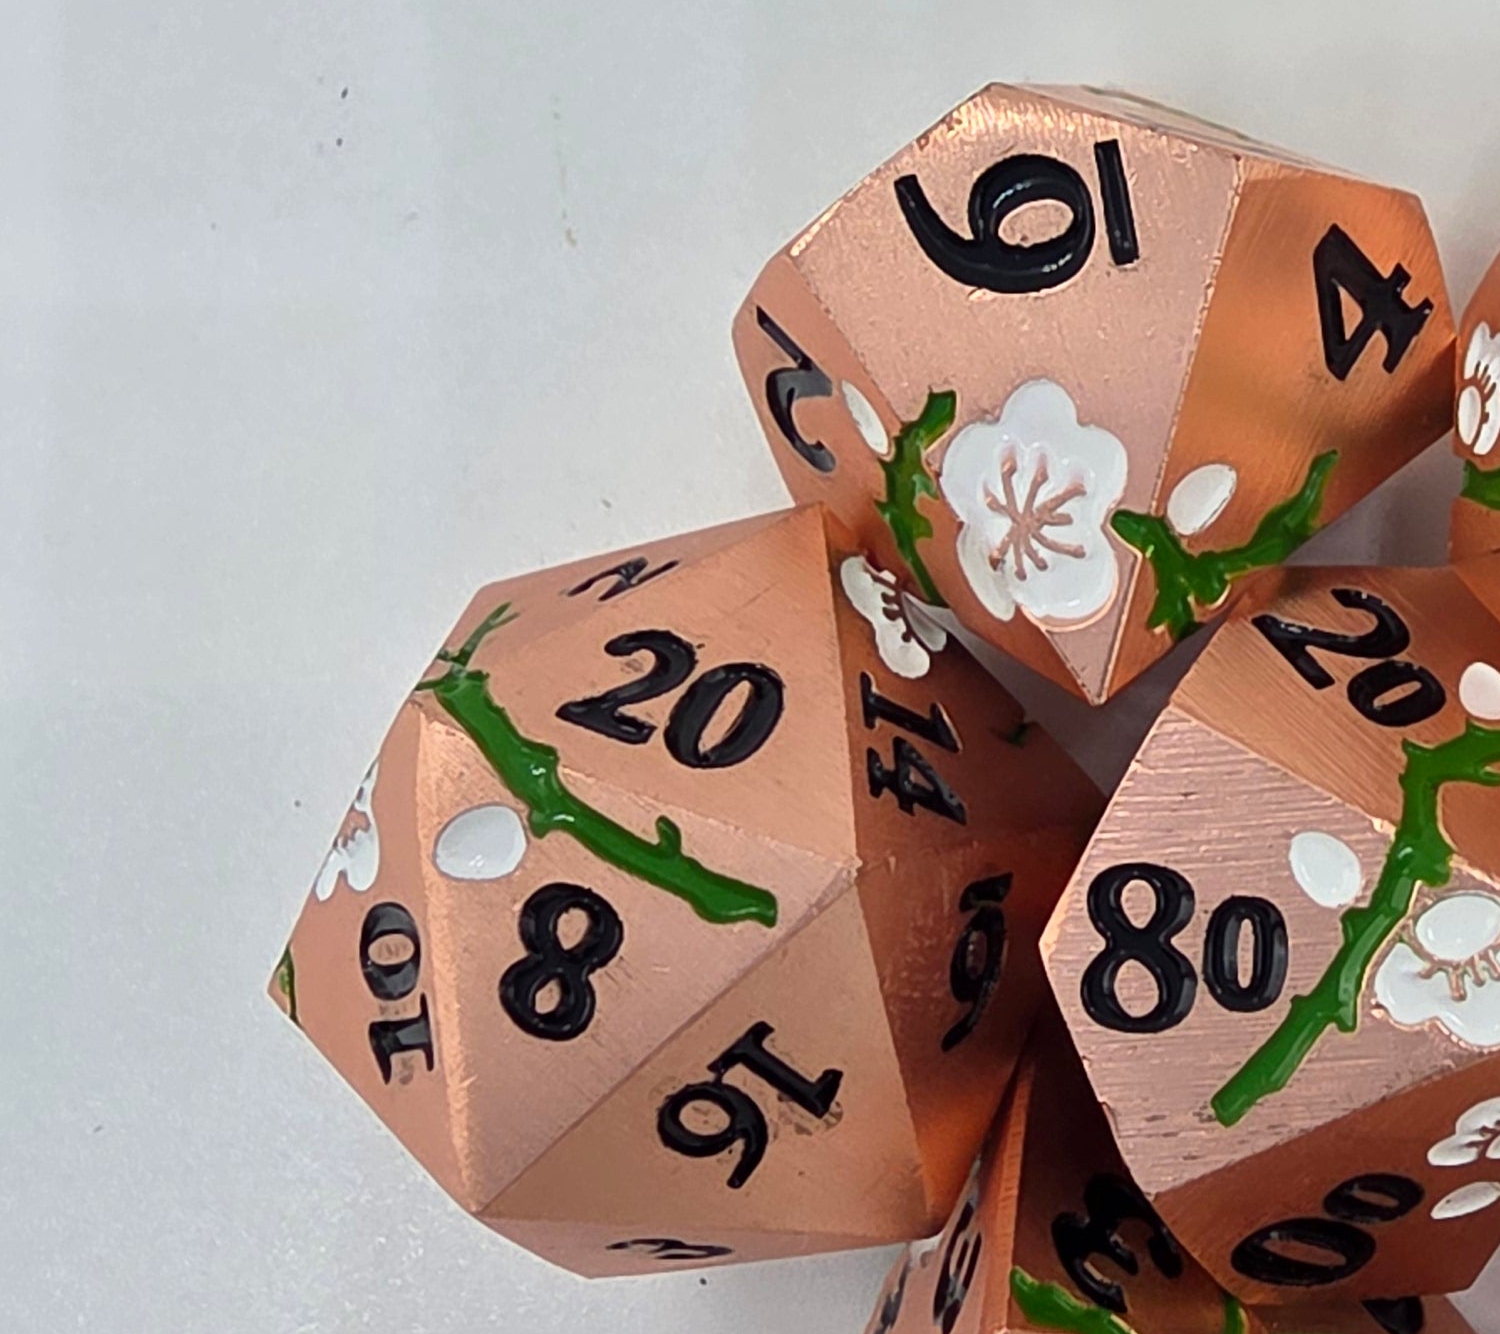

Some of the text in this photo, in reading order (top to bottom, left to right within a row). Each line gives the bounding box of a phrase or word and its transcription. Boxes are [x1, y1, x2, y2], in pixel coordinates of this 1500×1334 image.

[892, 137, 1141, 295] 6
[1311, 222, 1435, 383] 4
[555, 628, 785, 769] 20
[1252, 587, 1447, 728] 20
[860, 670, 968, 826] 14
[358, 901, 435, 1085] 10
[498, 881, 625, 1043] 8
[1079, 861, 1290, 1033] 80
[656, 1020, 844, 1190] 16
[1229, 1172, 1426, 1289] 00
